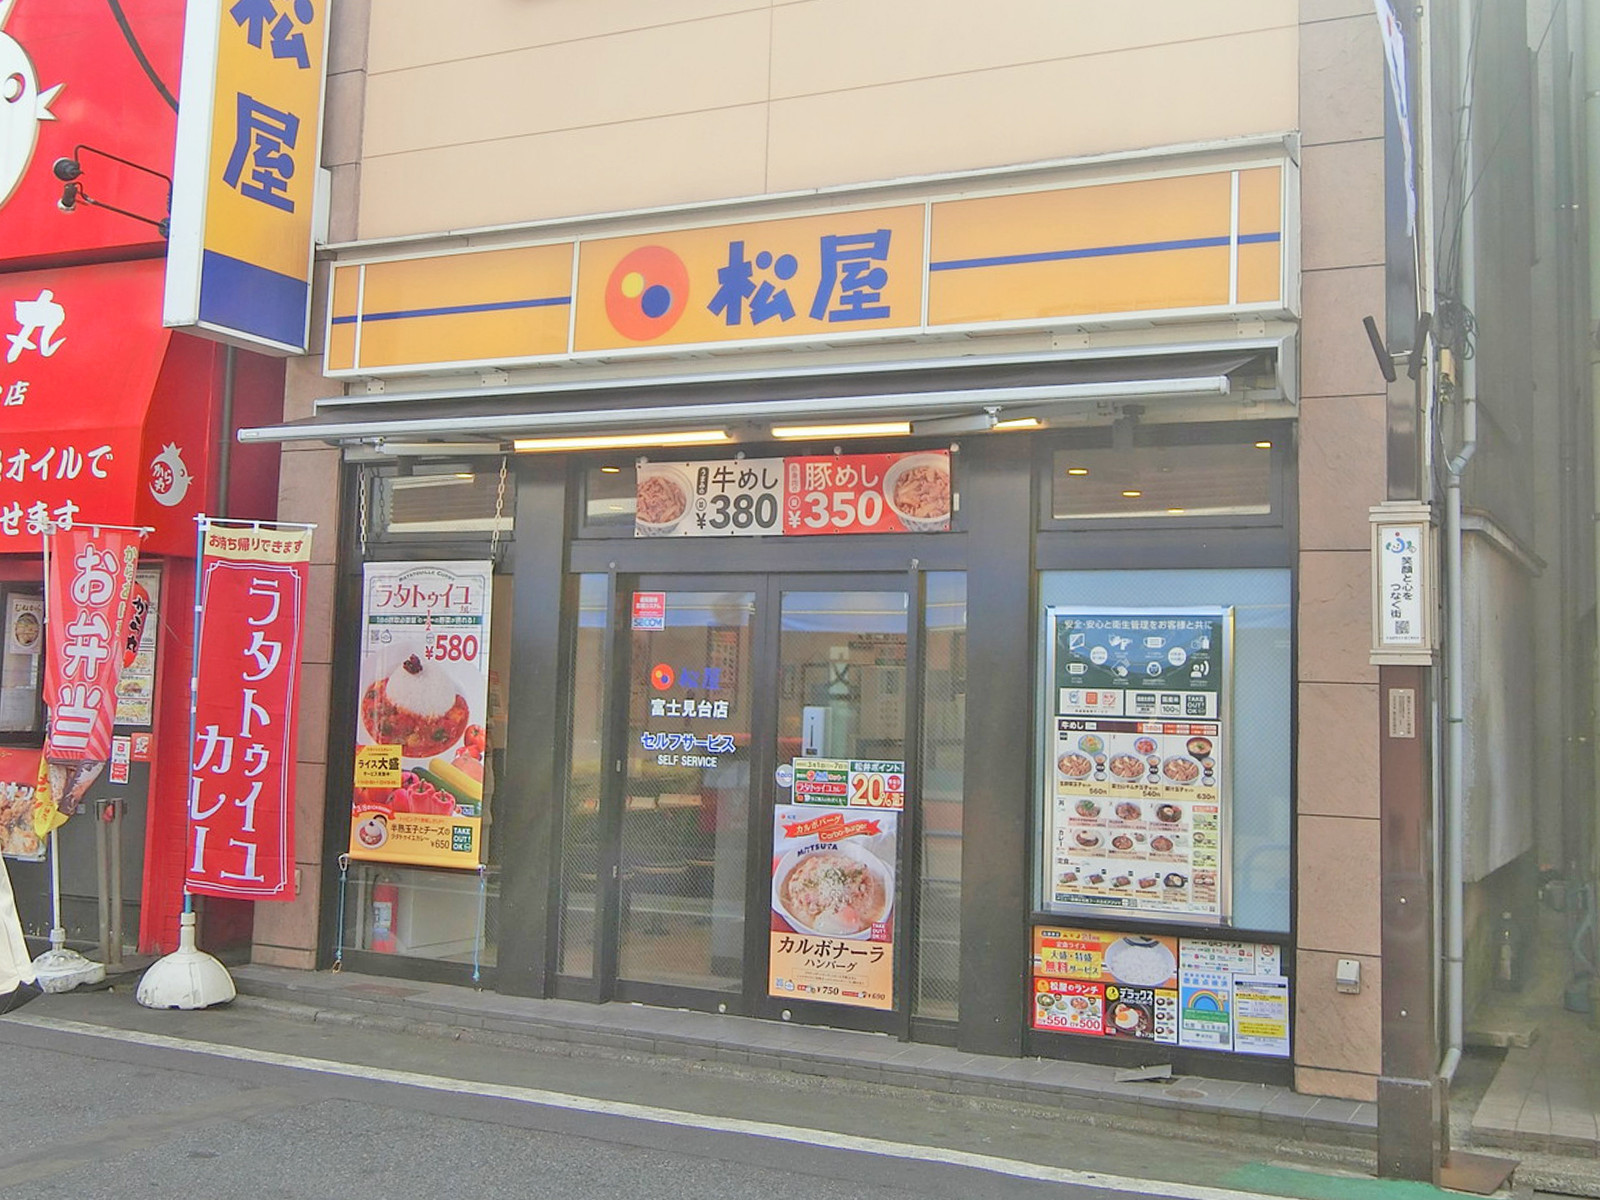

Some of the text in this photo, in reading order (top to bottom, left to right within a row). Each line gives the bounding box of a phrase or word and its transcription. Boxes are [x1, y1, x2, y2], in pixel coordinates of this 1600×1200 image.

[222, 0, 313, 214] 松屋
[707, 229, 892, 326] 松屋
[6, 289, 66, 363] 丸
[0, 381, 30, 406] 店
[0, 445, 113, 482] オイルで
[805, 462, 879, 490] 豚めし
[712, 466, 778, 492] 牛めし
[209, 535, 303, 554] お持ち帰りできます
[376, 583, 472, 608] ラタトゥイユ
[51, 544, 119, 750] お弁当
[425, 634, 479, 661] ¥580
[651, 699, 729, 718] 富士見台店
[221, 577, 283, 882] ラタトゥイユ
[641, 732, 736, 752] セルフサービス
[358, 757, 399, 770] ライス大盛
[657, 755, 717, 767] SELF SERVICE
[190, 725, 234, 874] カレー
[777, 936, 885, 963] カルボナーラ
[805, 959, 857, 972] ハンバーグ
